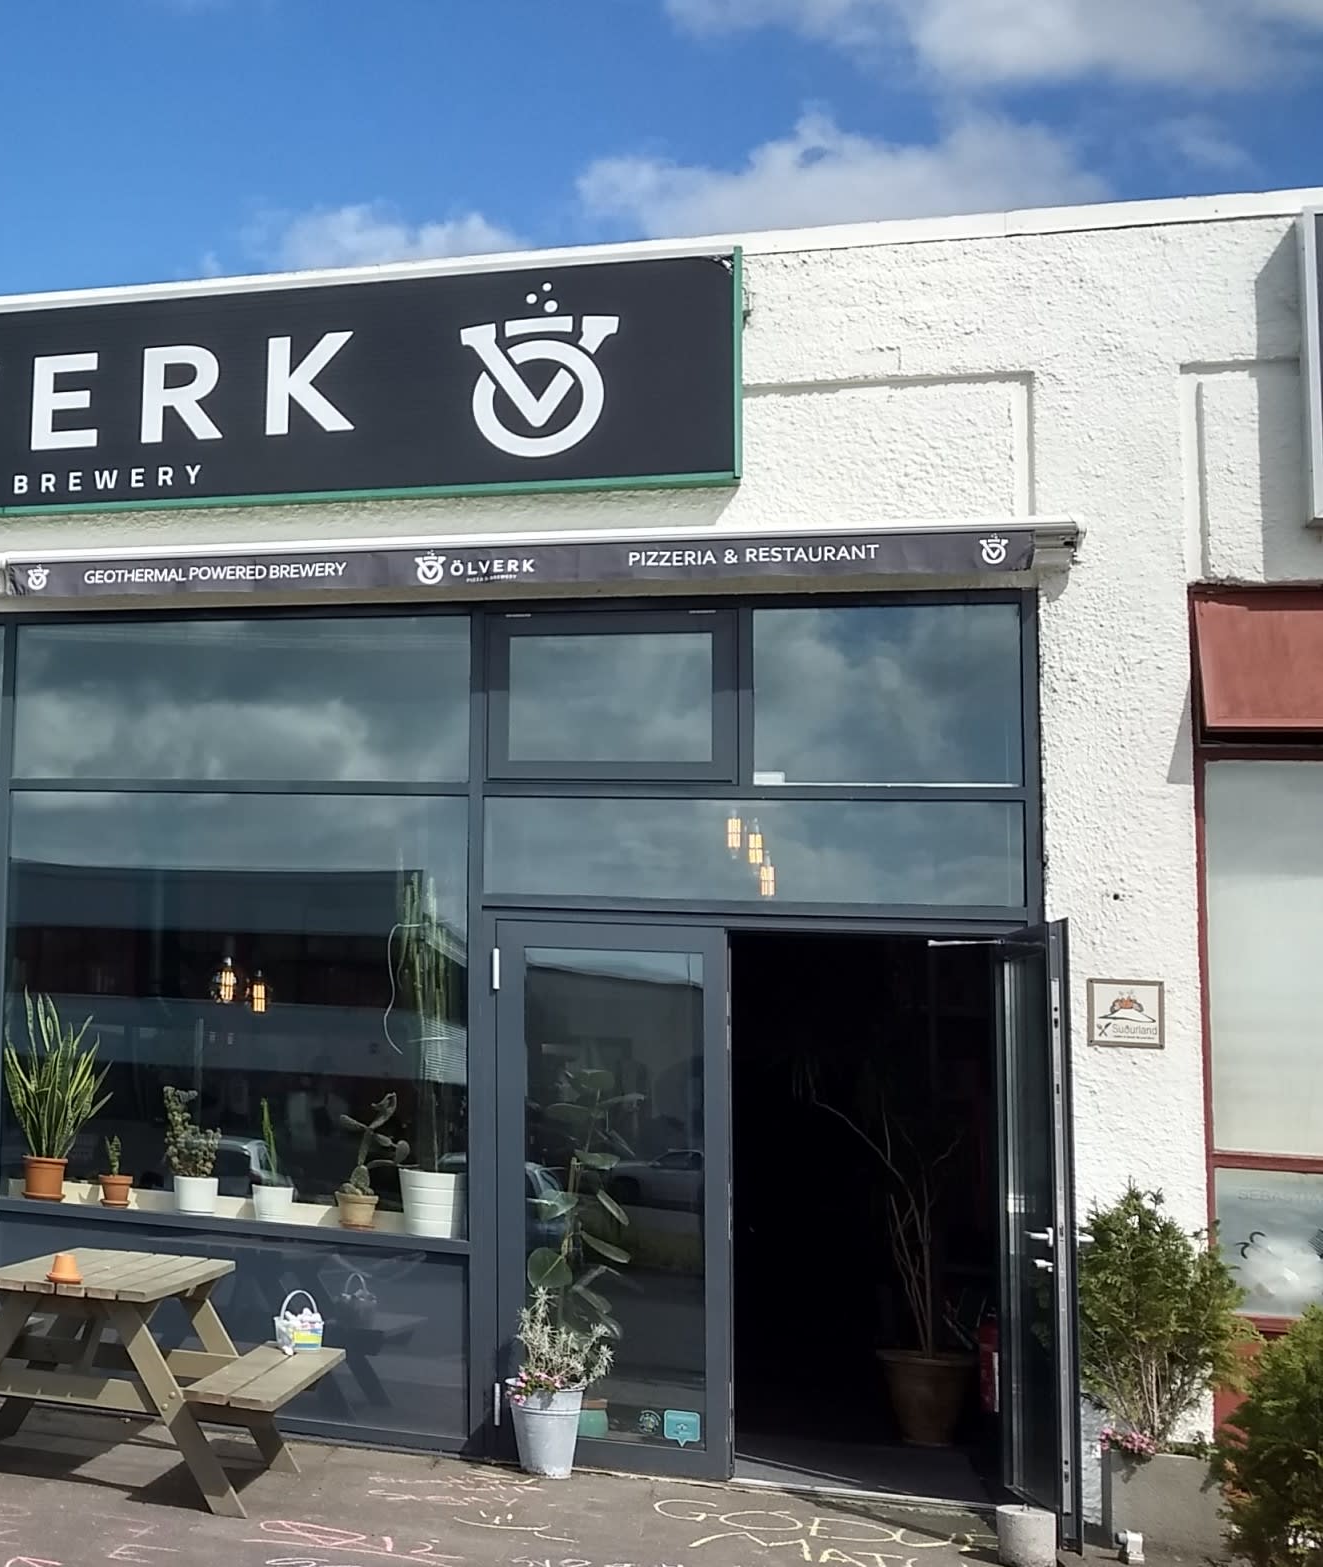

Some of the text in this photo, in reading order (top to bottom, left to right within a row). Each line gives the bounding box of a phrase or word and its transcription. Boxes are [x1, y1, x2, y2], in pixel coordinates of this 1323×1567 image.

[13, 464, 202, 494] BREWERY
[628, 544, 880, 567] PIZZERIA & RESTAURANT
[84, 562, 347, 584] GEOTHERMAL POWERED BREWERY
[450, 559, 535, 576] ÖLVERK
